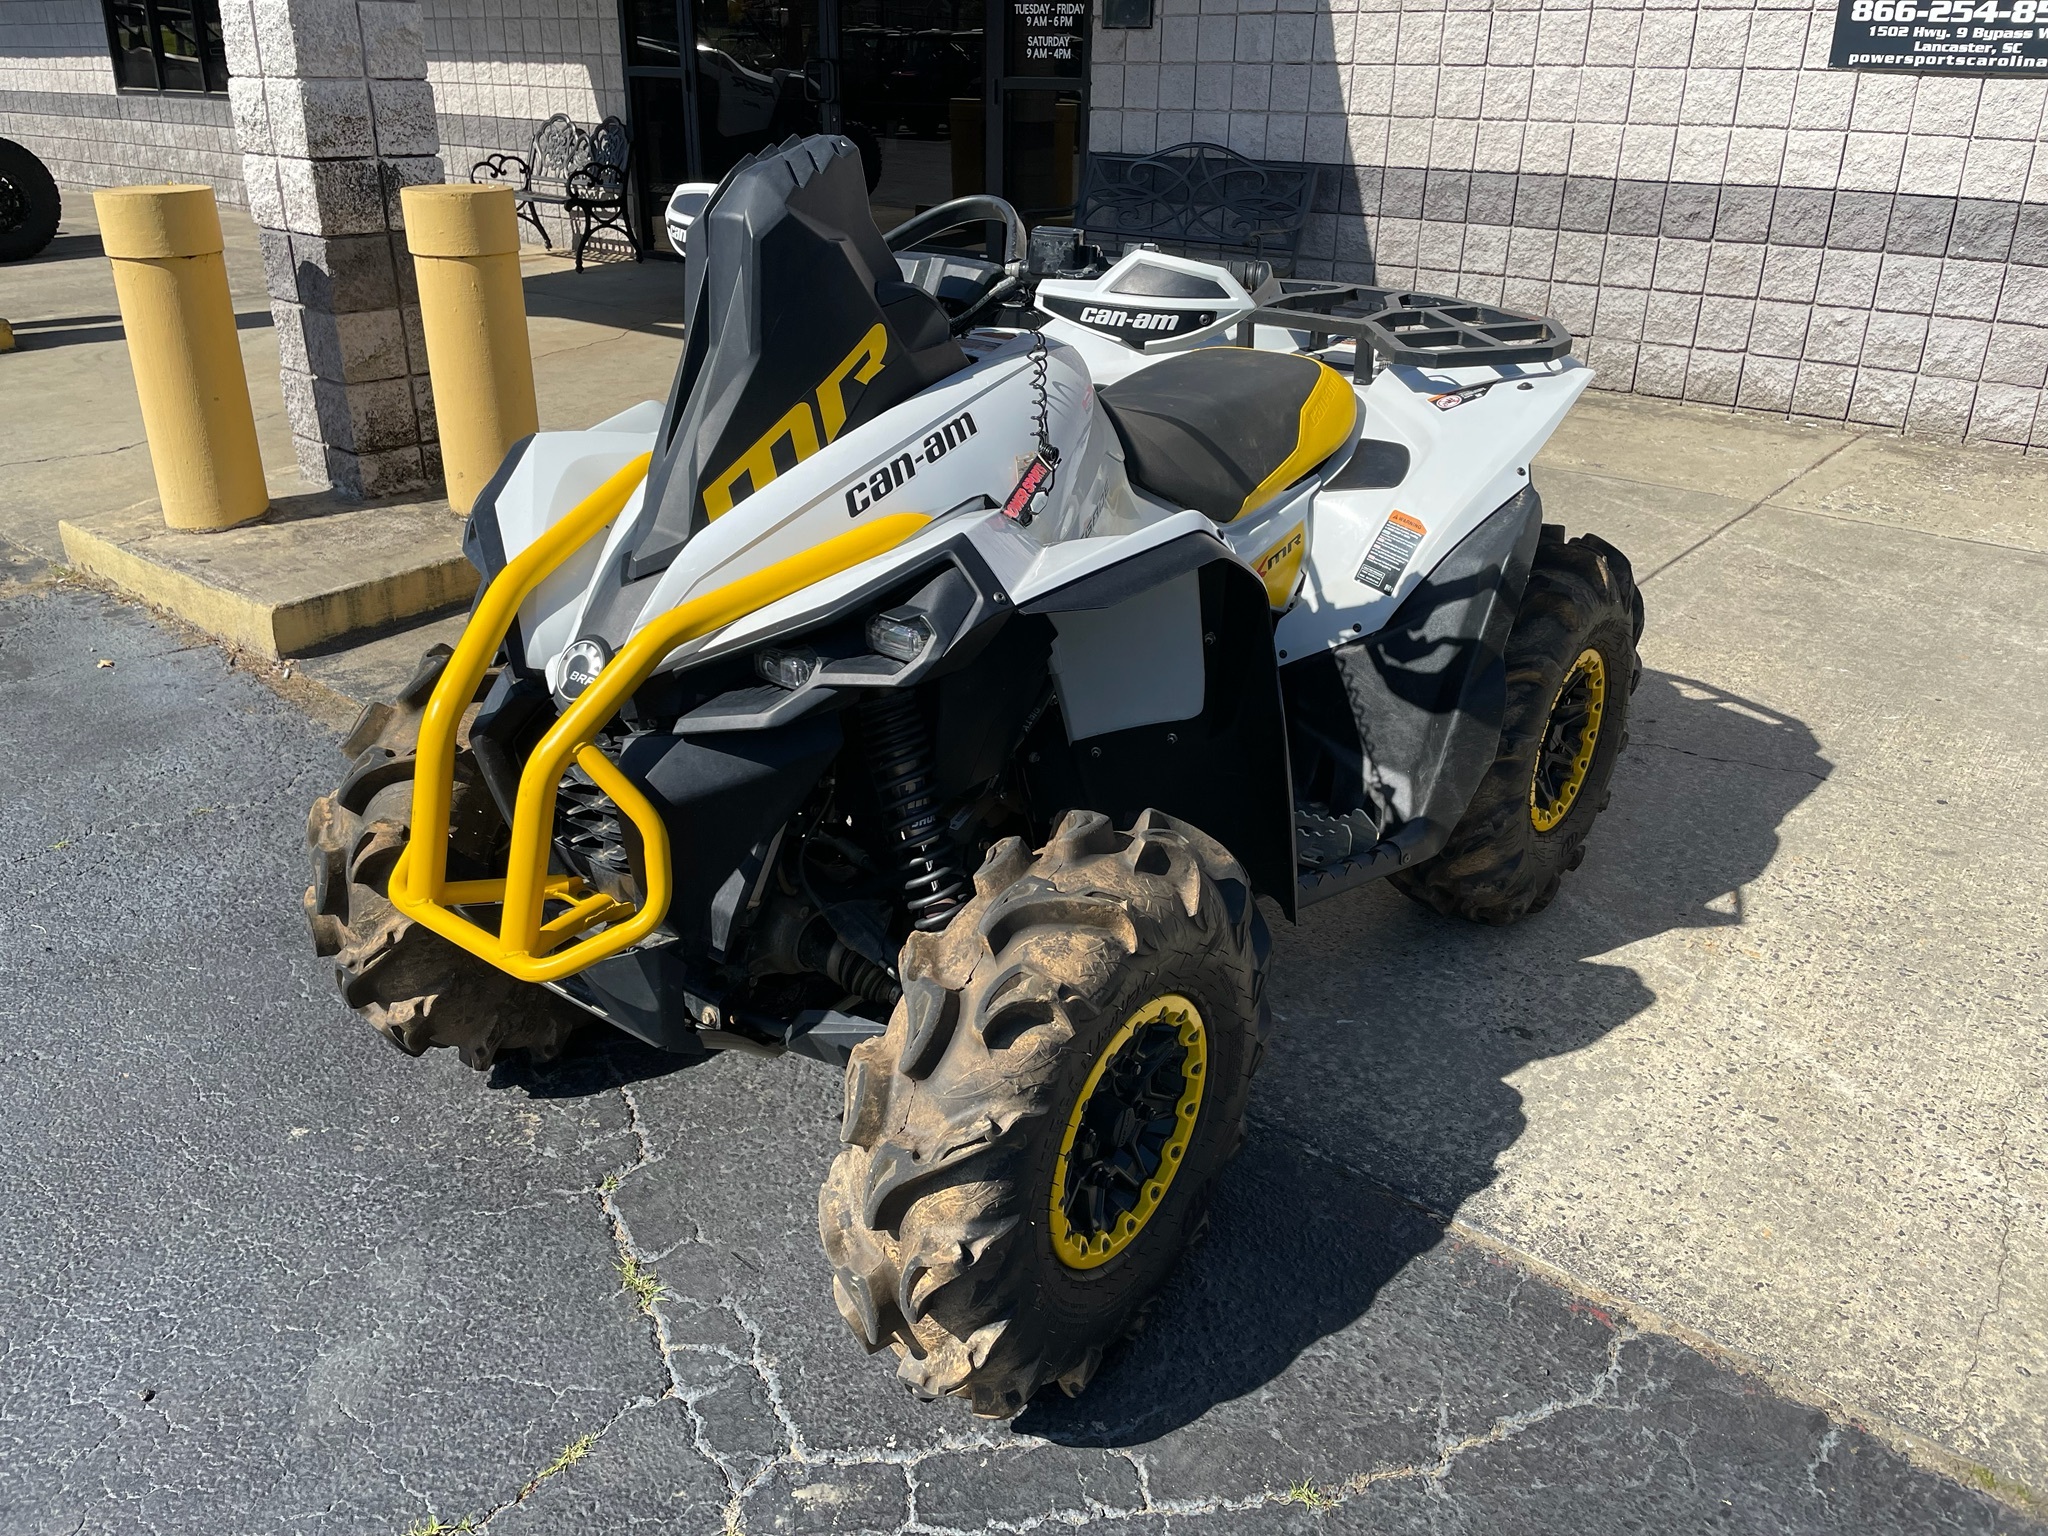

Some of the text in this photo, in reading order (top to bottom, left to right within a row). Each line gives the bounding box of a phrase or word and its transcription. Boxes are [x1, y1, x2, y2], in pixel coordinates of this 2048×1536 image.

[1014, 4, 1050, 15] TUESDAY
[1056, 4, 1085, 15] FRIDAY
[1851, 0, 2048, 23] 866-254-85
[1026, 17, 1031, 26] 9
[1033, 16, 1048, 27] AM
[1053, 16, 1059, 27] 6
[1060, 16, 1073, 27] PM
[1869, 26, 1909, 37] 1502
[1913, 26, 1951, 40] Hwy.
[1956, 27, 1968, 38] 9
[1972, 27, 2034, 40] Bypass
[1027, 36, 1071, 47] SATURDAY
[1914, 41, 2024, 55] Lancaster, SC
[1026, 48, 1031, 58] 9
[1033, 48, 1048, 59] AM
[1053, 49, 1071, 59] 4PM
[1080, 307, 1179, 331] can-am
[845, 411, 978, 519] can-am
[1022, 462, 1047, 493] SPORTS
